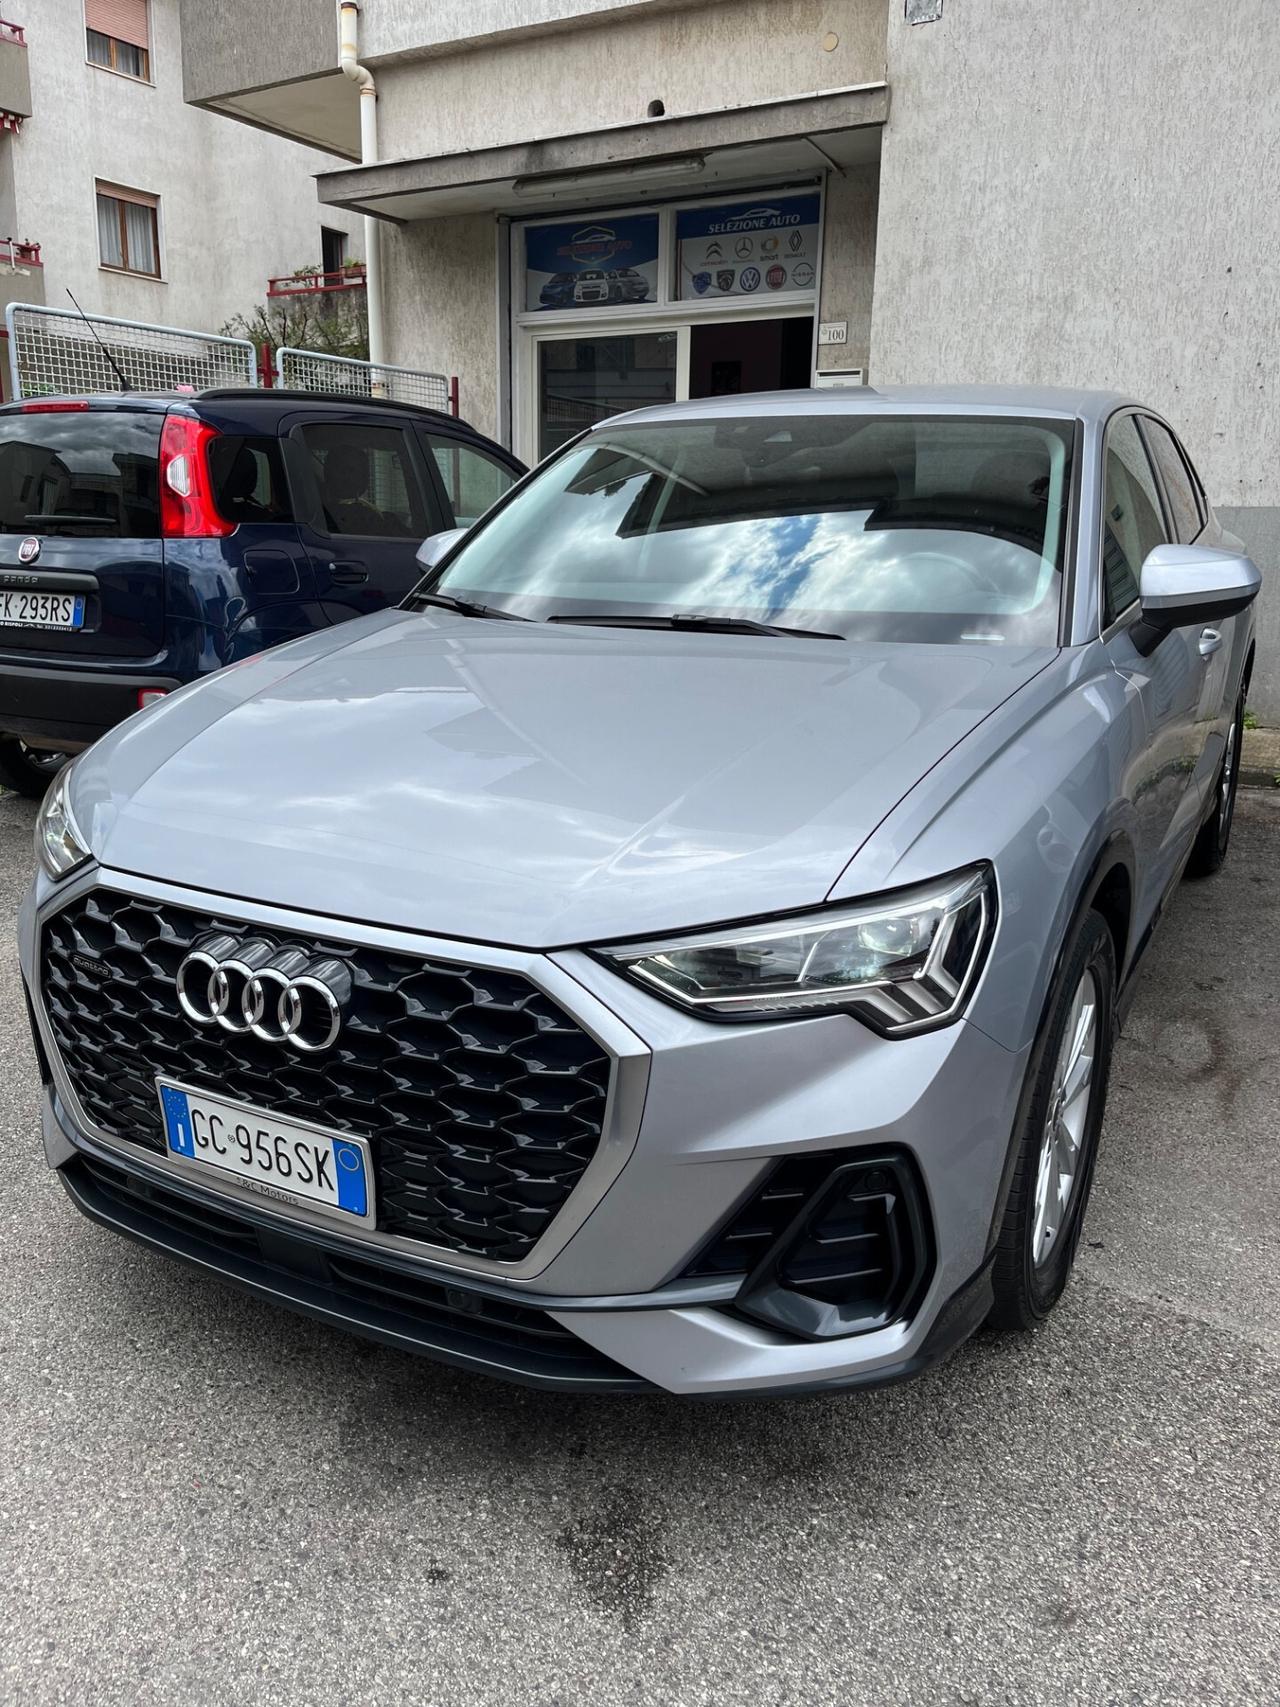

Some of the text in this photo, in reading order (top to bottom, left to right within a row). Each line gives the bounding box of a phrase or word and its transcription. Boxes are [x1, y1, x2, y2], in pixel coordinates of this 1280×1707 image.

[708, 214, 801, 234] SELEZIONE AUTO
[827, 328, 845, 341] 100
[19, 594, 72, 623] 293RS
[191, 1108, 336, 1192] GC 956SK
[260, 1185, 299, 1206] Motors
